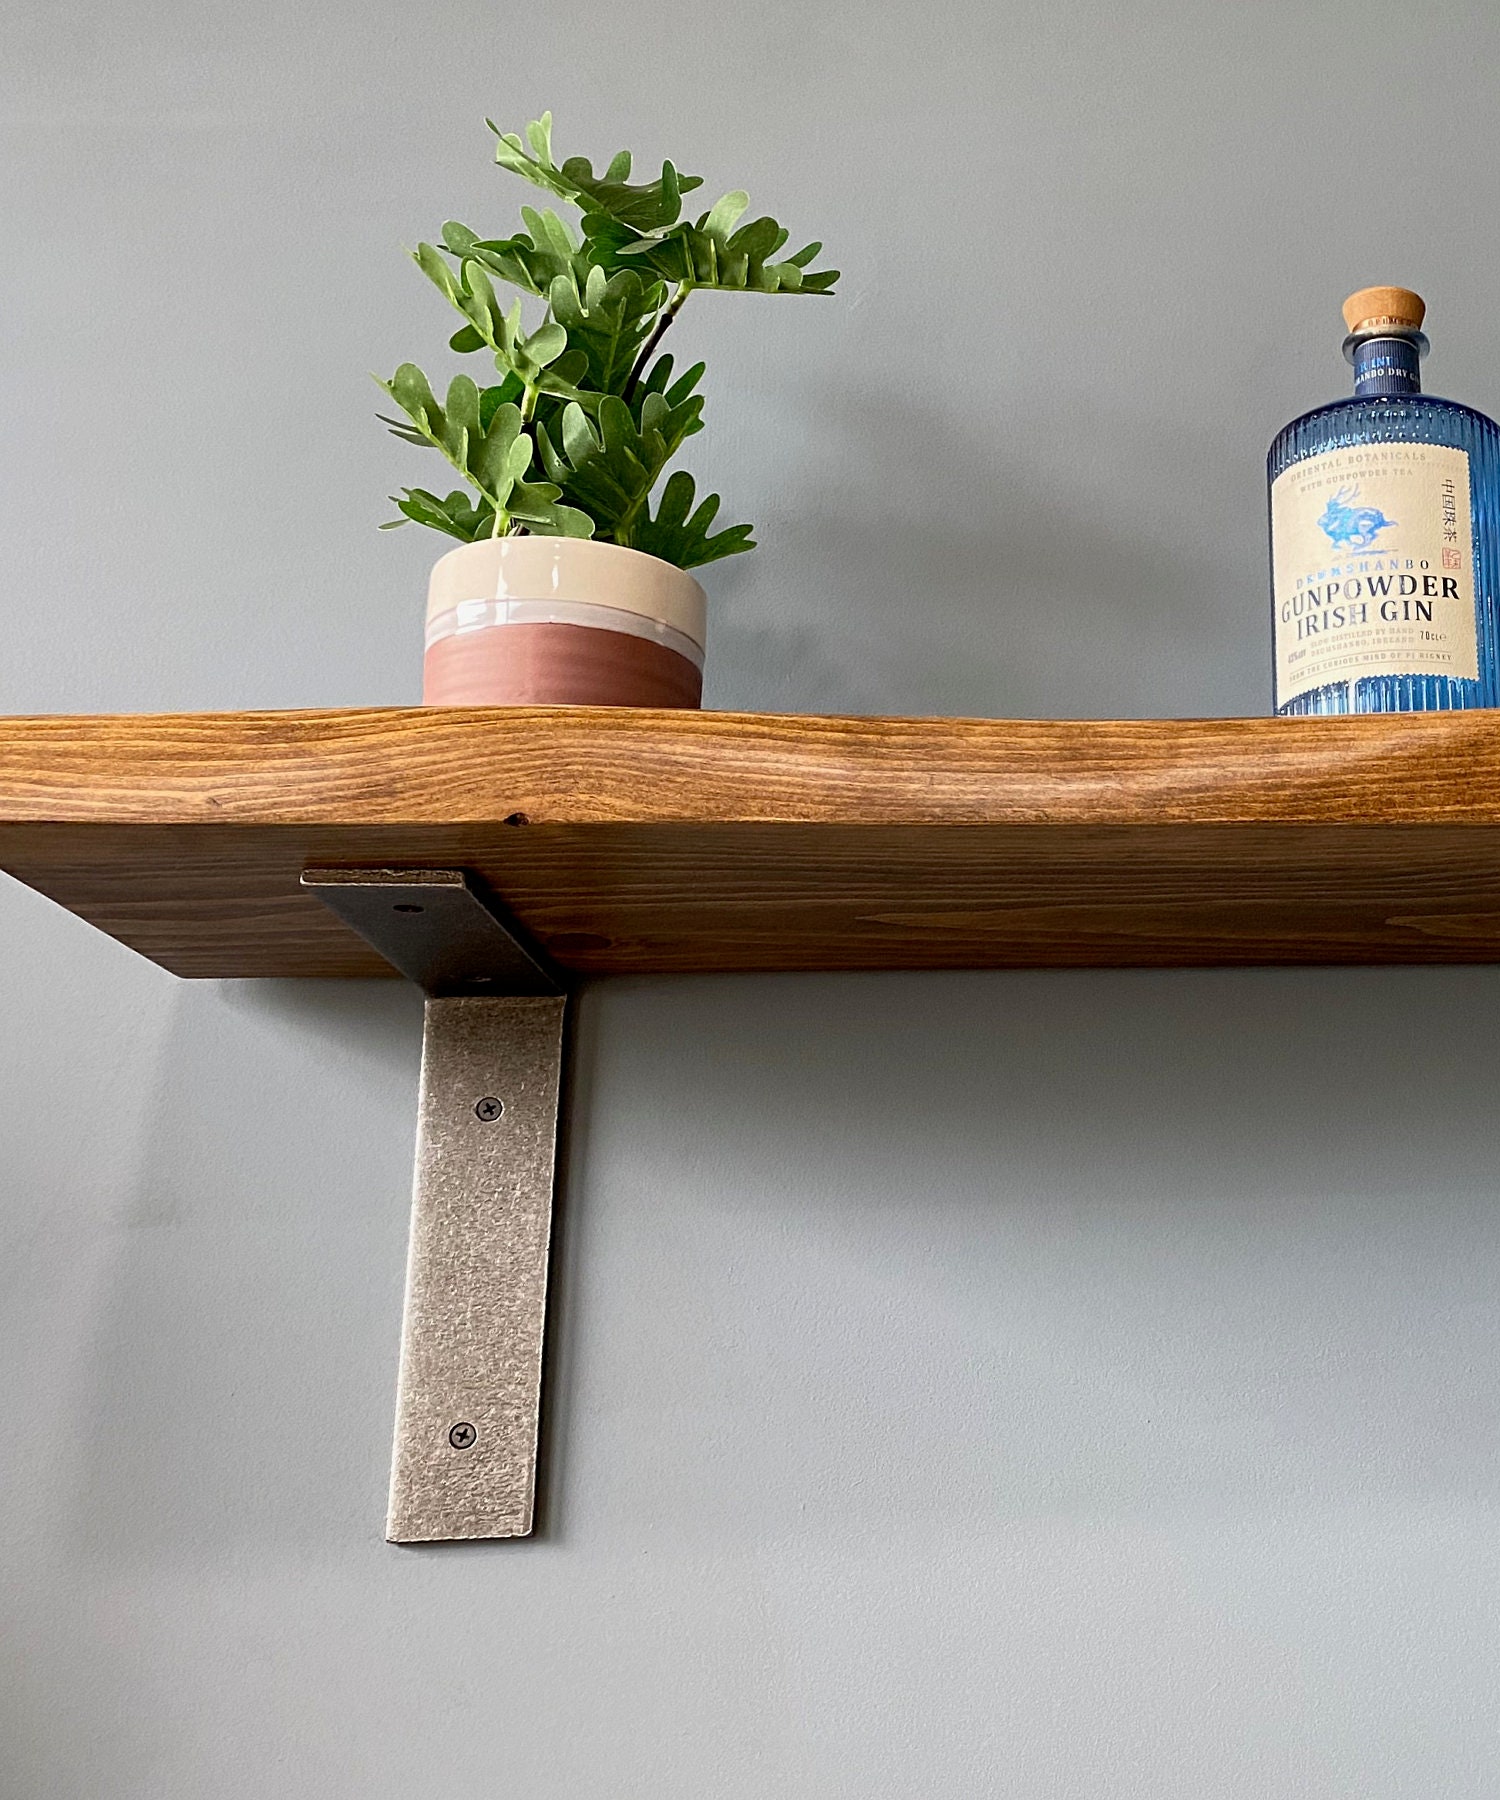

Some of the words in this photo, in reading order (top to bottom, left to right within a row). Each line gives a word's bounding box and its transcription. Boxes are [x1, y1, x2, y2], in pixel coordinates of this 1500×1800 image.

[1388, 367, 1408, 379] DRY
[1290, 457, 1342, 483] ORIENTAL
[1348, 451, 1426, 464] BOTANICALS
[1326, 468, 1388, 485] GUNPOWDER
[1394, 468, 1414, 477] TEA
[1296, 559, 1430, 590] DRUMSHANBO
[1281, 574, 1460, 624] GUNPOWDER
[1297, 602, 1369, 641] IRISH
[1380, 600, 1433, 622] GIN
